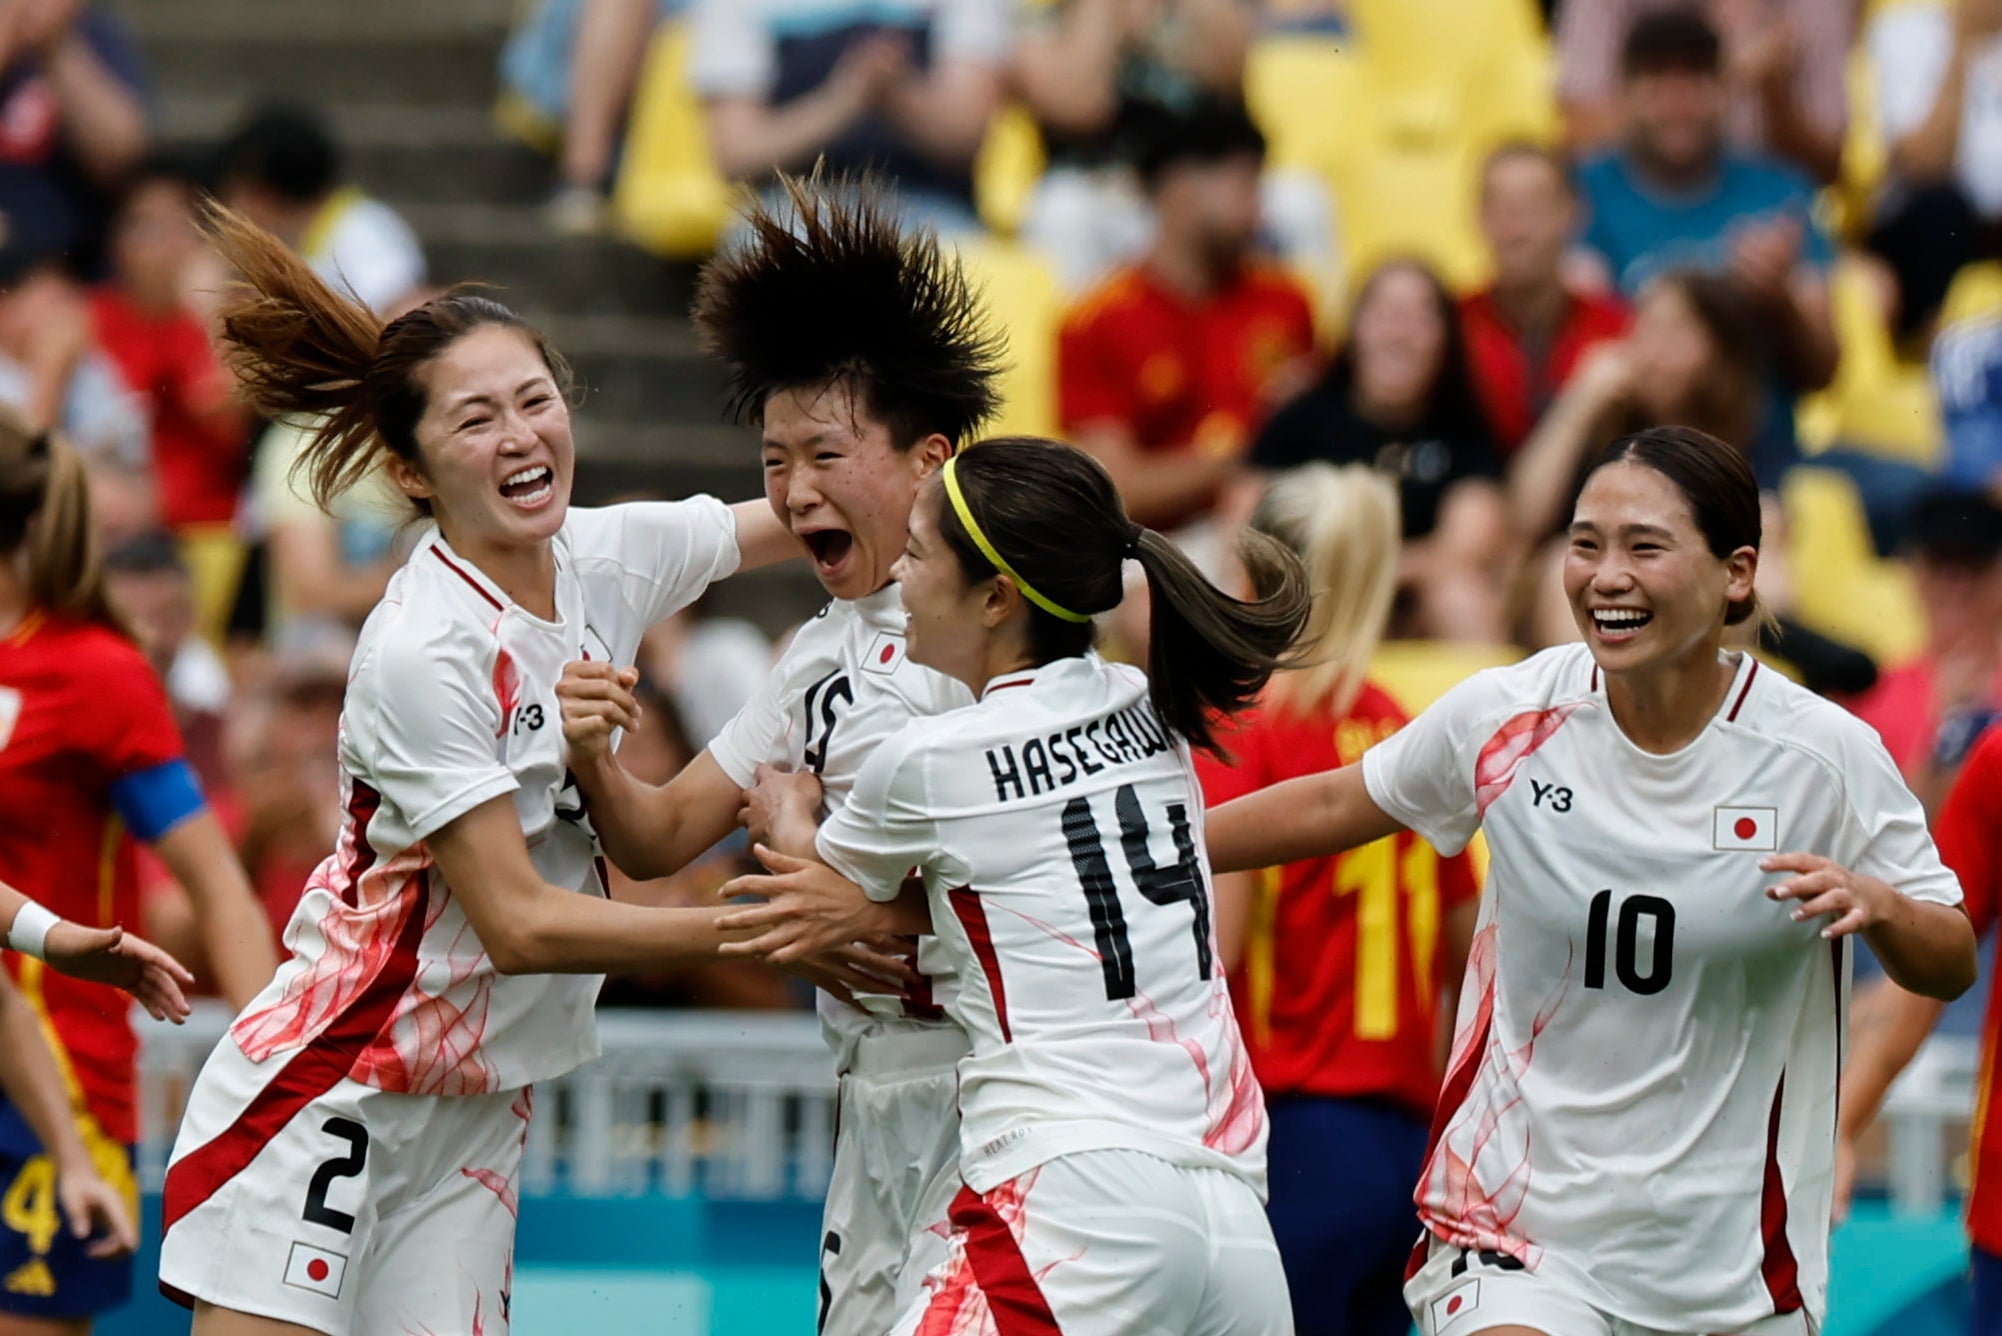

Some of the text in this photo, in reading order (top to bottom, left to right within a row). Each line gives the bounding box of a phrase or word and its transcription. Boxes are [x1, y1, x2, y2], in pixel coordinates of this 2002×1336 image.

[986, 700, 1170, 802] HASEGAW
[1061, 783, 1213, 1001] 14
[1333, 832, 1441, 1042] 11
[1584, 889, 1676, 996] 10
[3, 1156, 60, 1255] 4
[302, 1116, 369, 1235] 2
